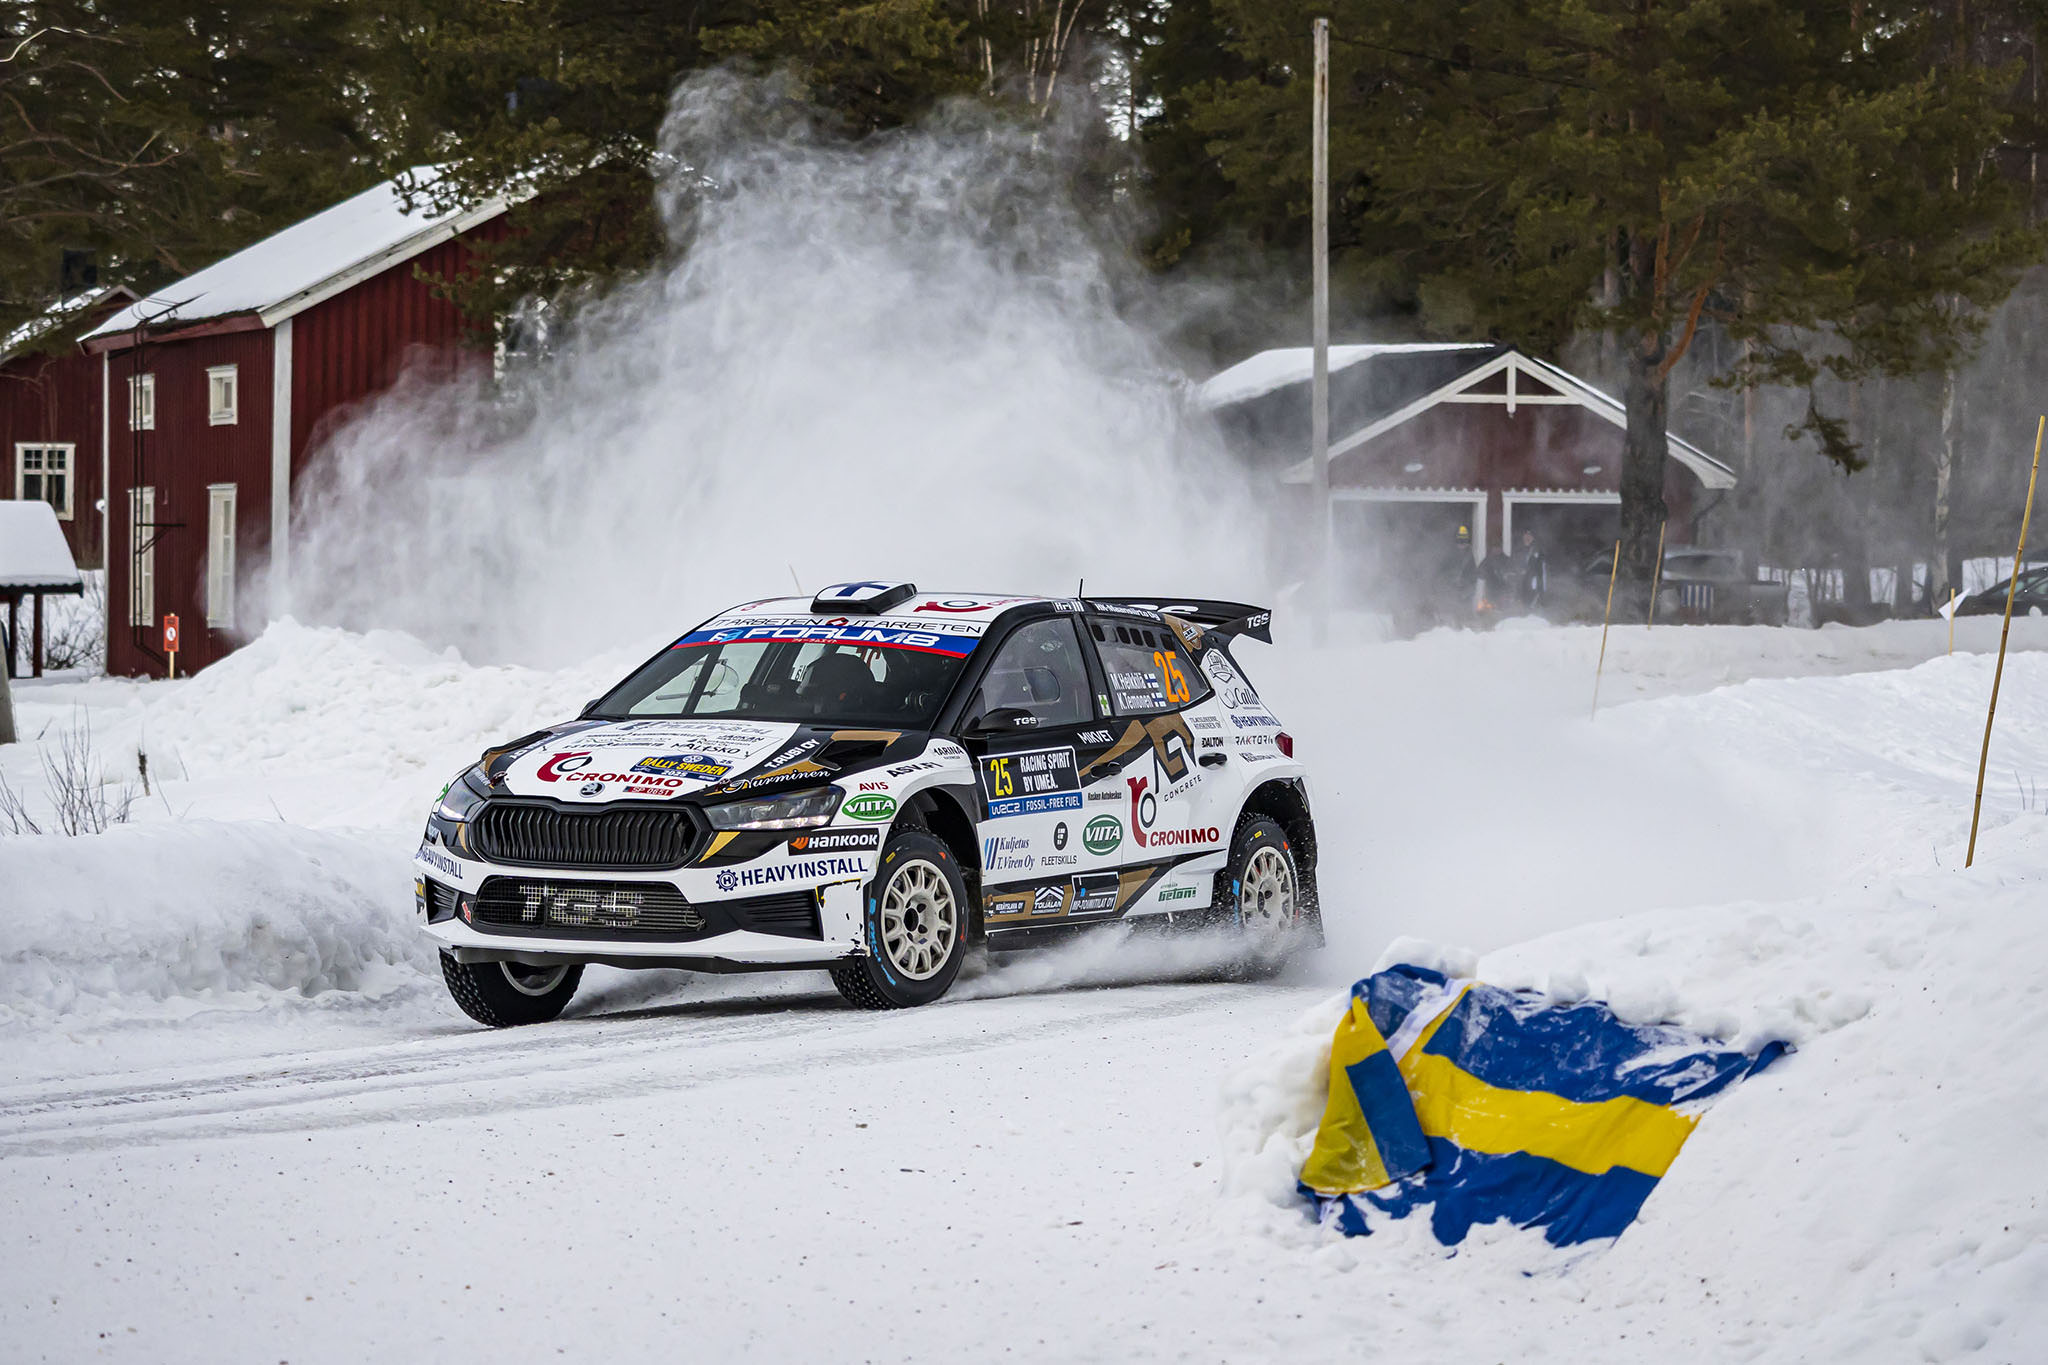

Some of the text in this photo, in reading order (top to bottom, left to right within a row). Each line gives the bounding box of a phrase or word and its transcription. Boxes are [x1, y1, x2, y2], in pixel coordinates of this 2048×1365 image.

[724, 618, 823, 627] ARBETEN
[873, 620, 981, 634] ARBETEN
[1246, 612, 1270, 629] TGS
[743, 627, 940, 647] FORUM8
[1154, 651, 1191, 703] 25
[1013, 716, 1037, 726] TGS
[764, 738, 820, 769] T.RUSI OY
[640, 757, 729, 776] RALLY SWEDEN
[886, 761, 944, 778] ASV.FI
[1020, 752, 1071, 773] RACING SPIRIT
[566, 772, 684, 788] CRONIMO
[859, 781, 889, 791] AVIS
[990, 758, 1014, 797] 25
[1022, 776, 1034, 793] BY
[1163, 774, 1202, 802] CONCRETE
[845, 800, 895, 813] VIITA
[991, 795, 1081, 815] WRC2 FOSSIL-FREE FUEL
[1086, 825, 1121, 842] VIITA
[1150, 827, 1220, 847] CRONIMO
[1000, 837, 1030, 854] Kuljetus
[997, 855, 1035, 871] T.Viren Oy
[1041, 855, 1078, 867] FLEETSKILLS
[741, 858, 869, 887] HEAVYINSTALL
[519, 884, 645, 928] TGS
